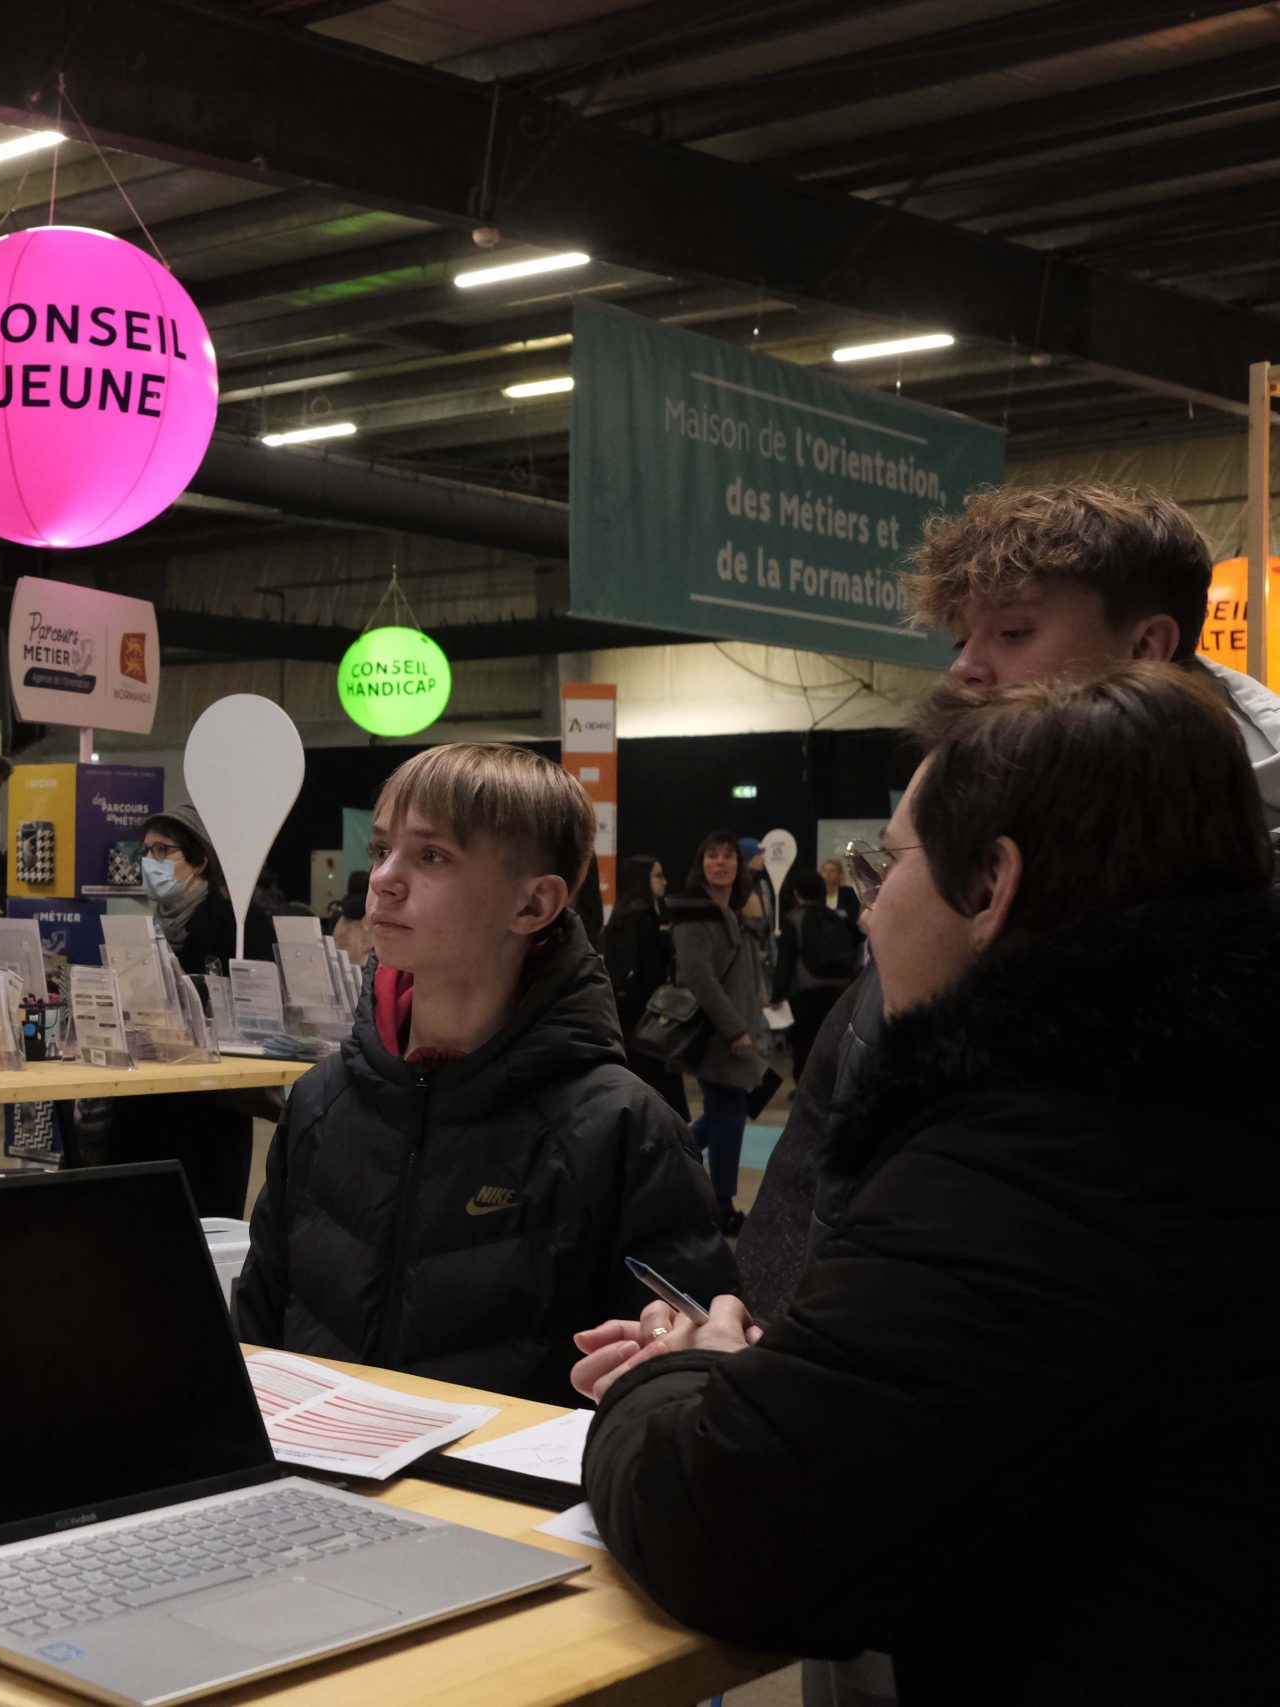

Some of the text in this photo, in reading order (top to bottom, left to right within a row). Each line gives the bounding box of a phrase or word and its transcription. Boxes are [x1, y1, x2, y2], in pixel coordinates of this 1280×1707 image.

[664, 396, 947, 507] Maison de l'Orientation,
[725, 476, 900, 551] des Métiers et
[716, 541, 748, 583] de
[757, 546, 781, 591] la
[29, 611, 81, 645] Parcours
[23, 641, 71, 665] MÉTIER
[351, 660, 428, 679] CONSEIL
[346, 678, 436, 697] HANDICAP
[101, 803, 149, 815] PARCOURS
[475, 1185, 516, 1206] NIKE
